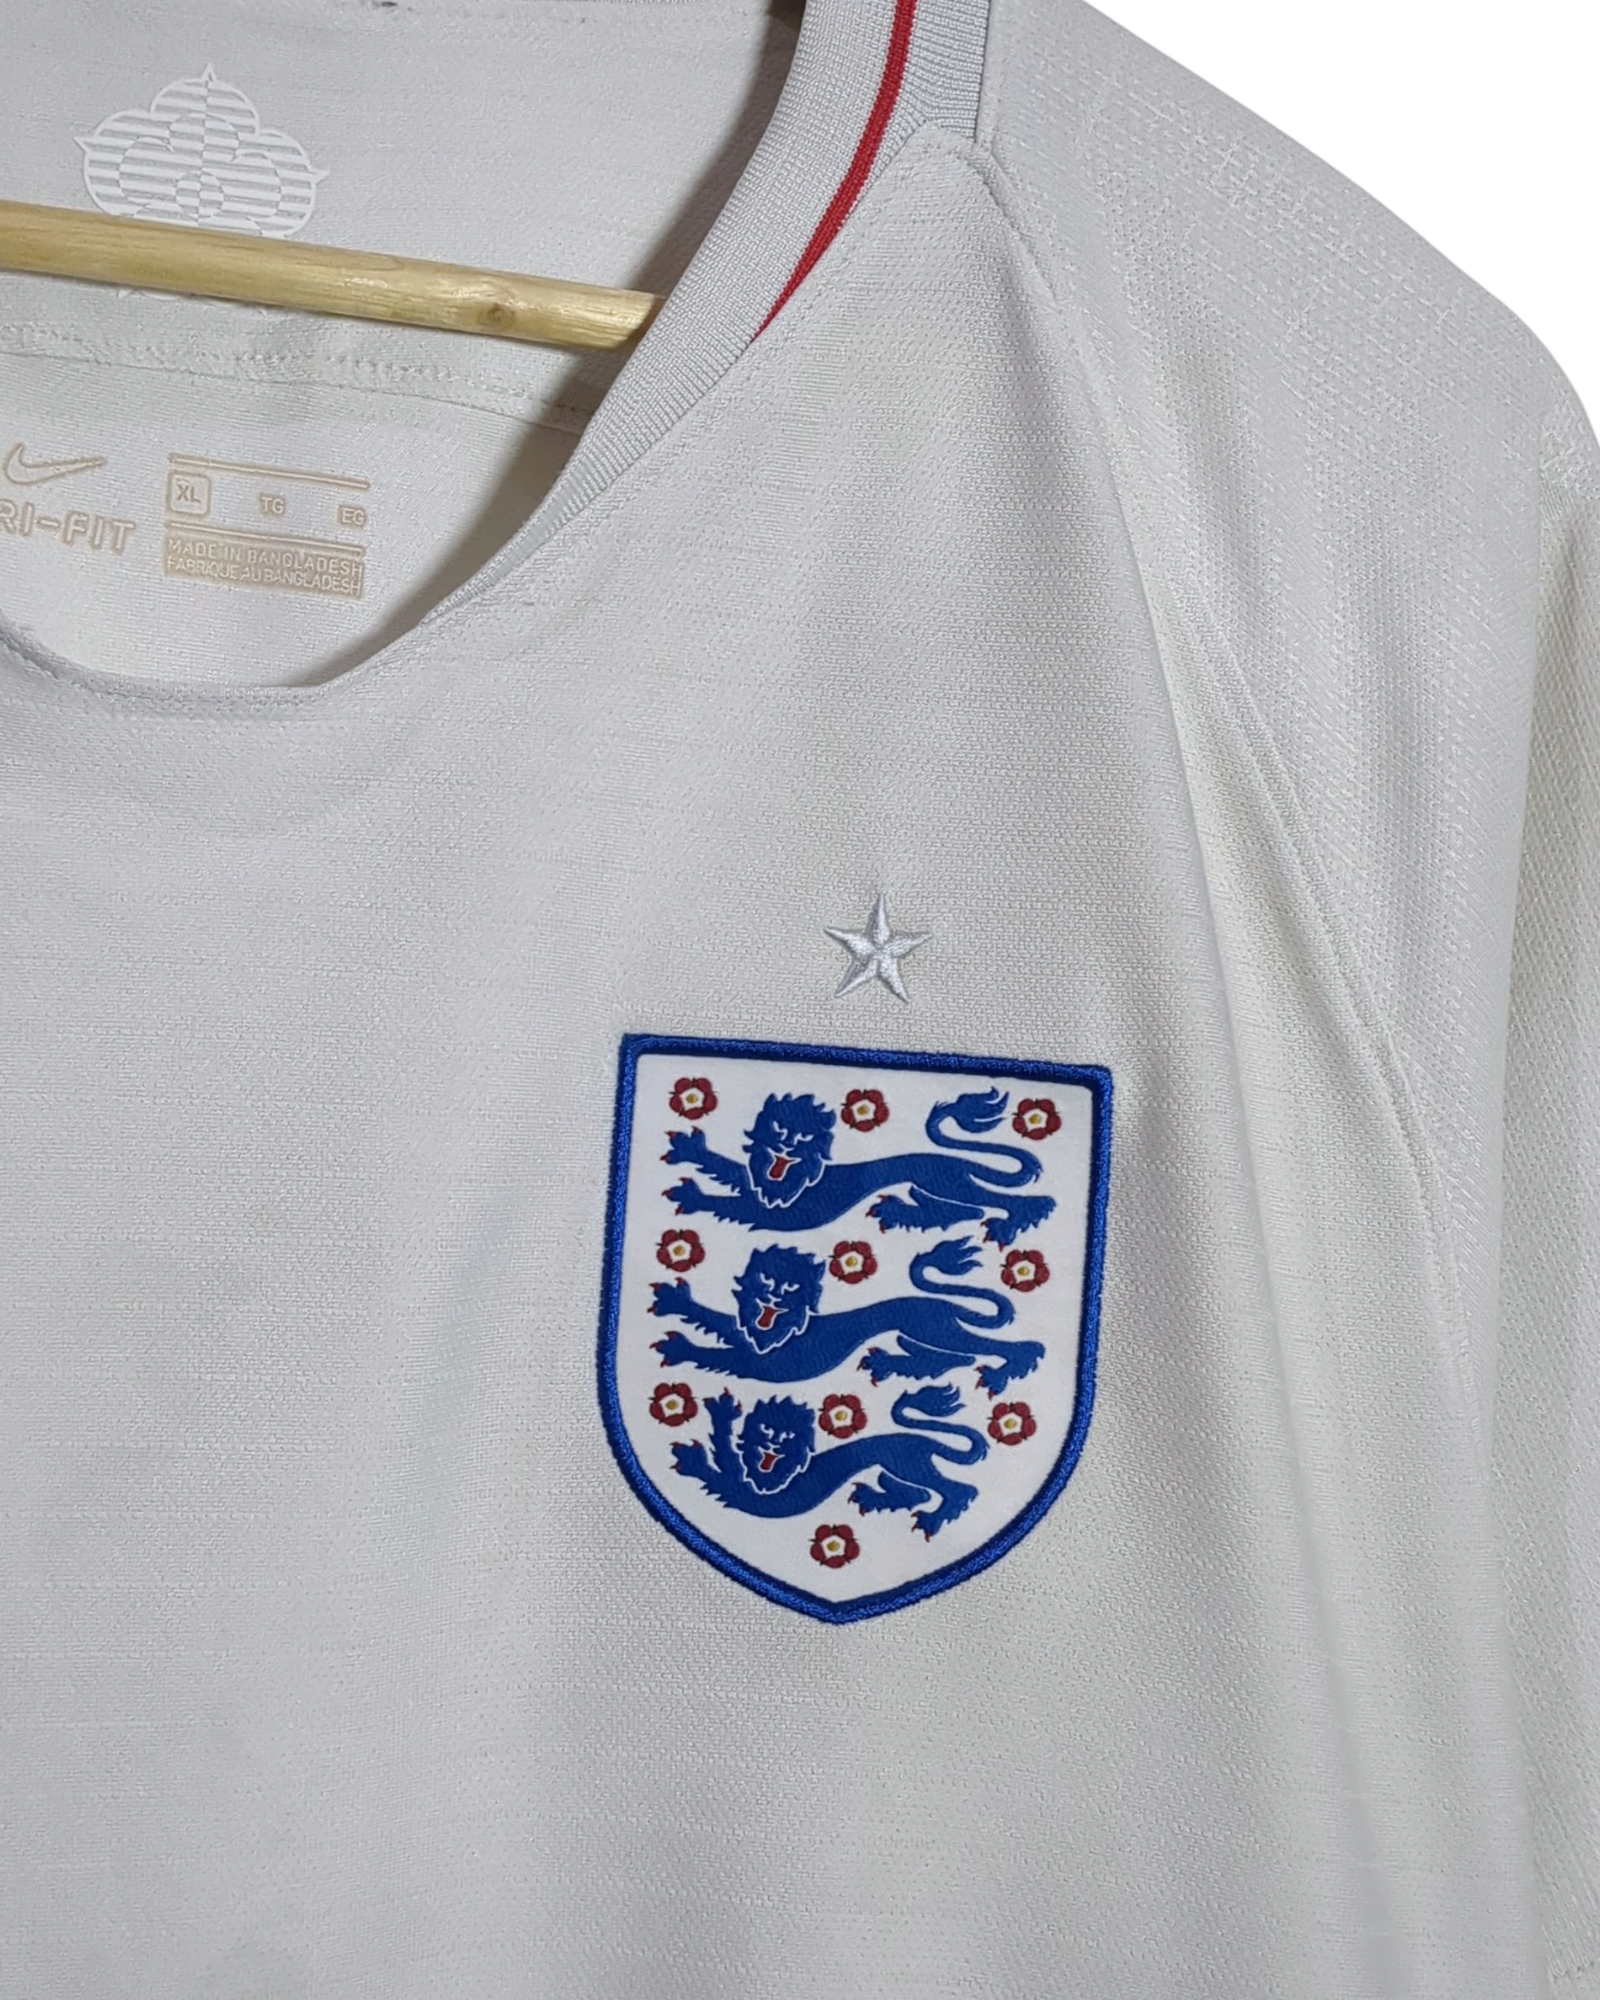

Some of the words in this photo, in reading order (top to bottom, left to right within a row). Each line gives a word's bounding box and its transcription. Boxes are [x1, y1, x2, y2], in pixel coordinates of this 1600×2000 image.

[176, 482, 202, 503] XL
[261, 496, 285, 514] TG
[341, 507, 365, 525] EG
[166, 555, 240, 580] FABRIQUE
[240, 566, 261, 582] AU
[263, 568, 361, 597] BANGLADESH
[167, 538, 217, 559] MADE
[224, 546, 241, 561] IN
[247, 549, 363, 579] BANGLADESH
